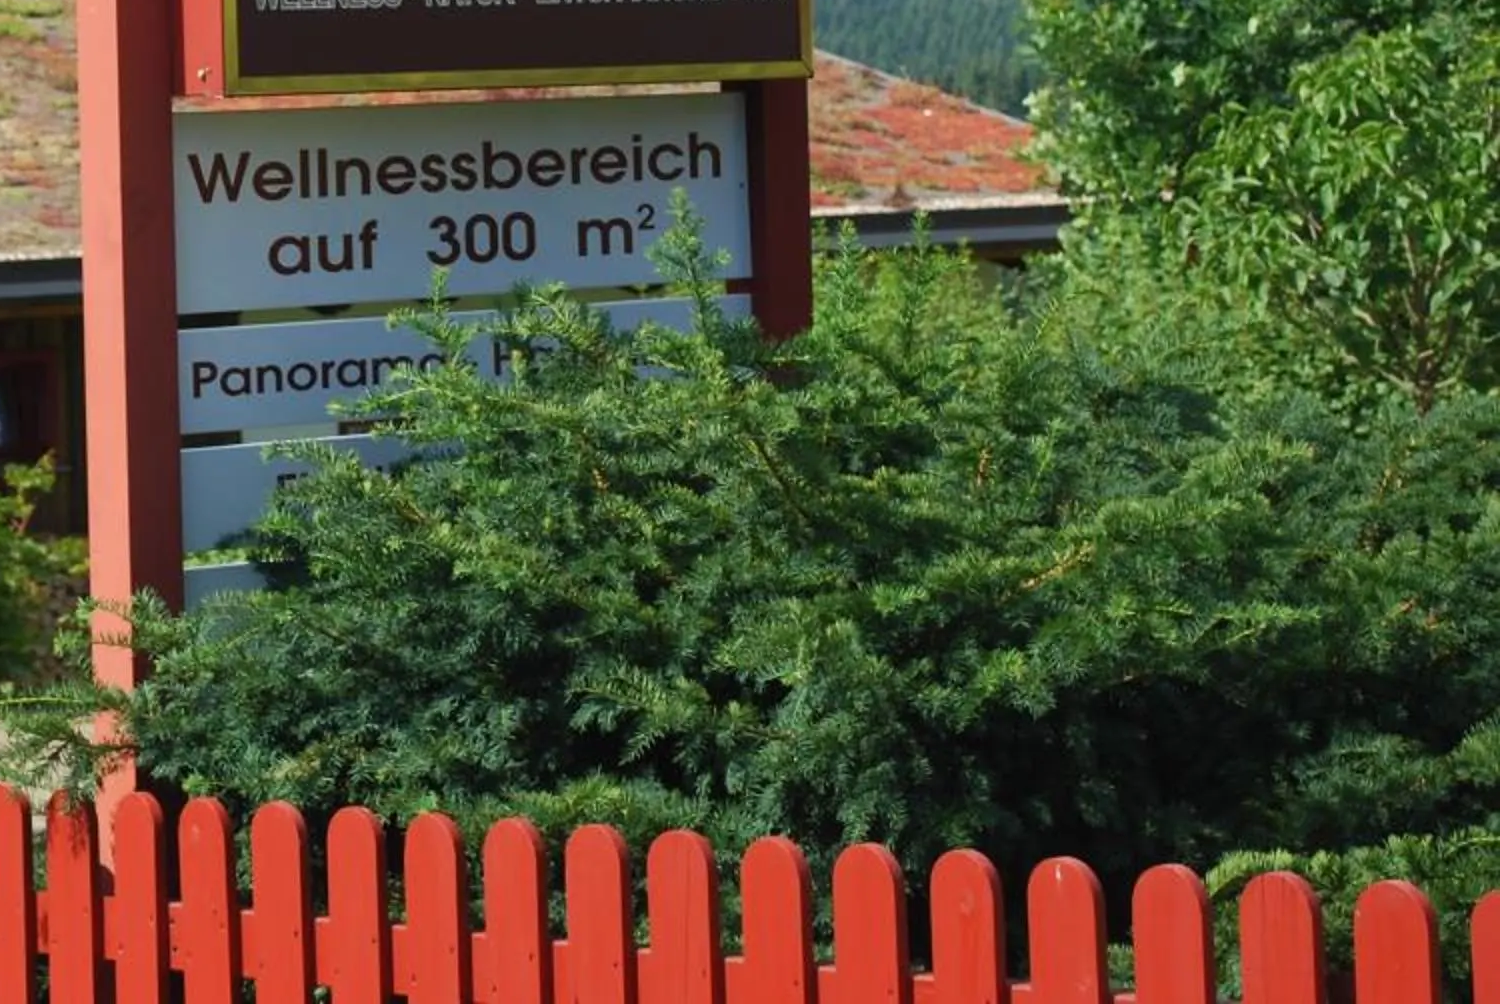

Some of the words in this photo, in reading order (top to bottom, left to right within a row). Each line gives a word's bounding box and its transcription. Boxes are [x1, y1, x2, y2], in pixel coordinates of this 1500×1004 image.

[187, 132, 722, 204] Wellnessbereich
[268, 219, 378, 276] auf
[426, 210, 537, 266] 300
[577, 203, 656, 257] m²
